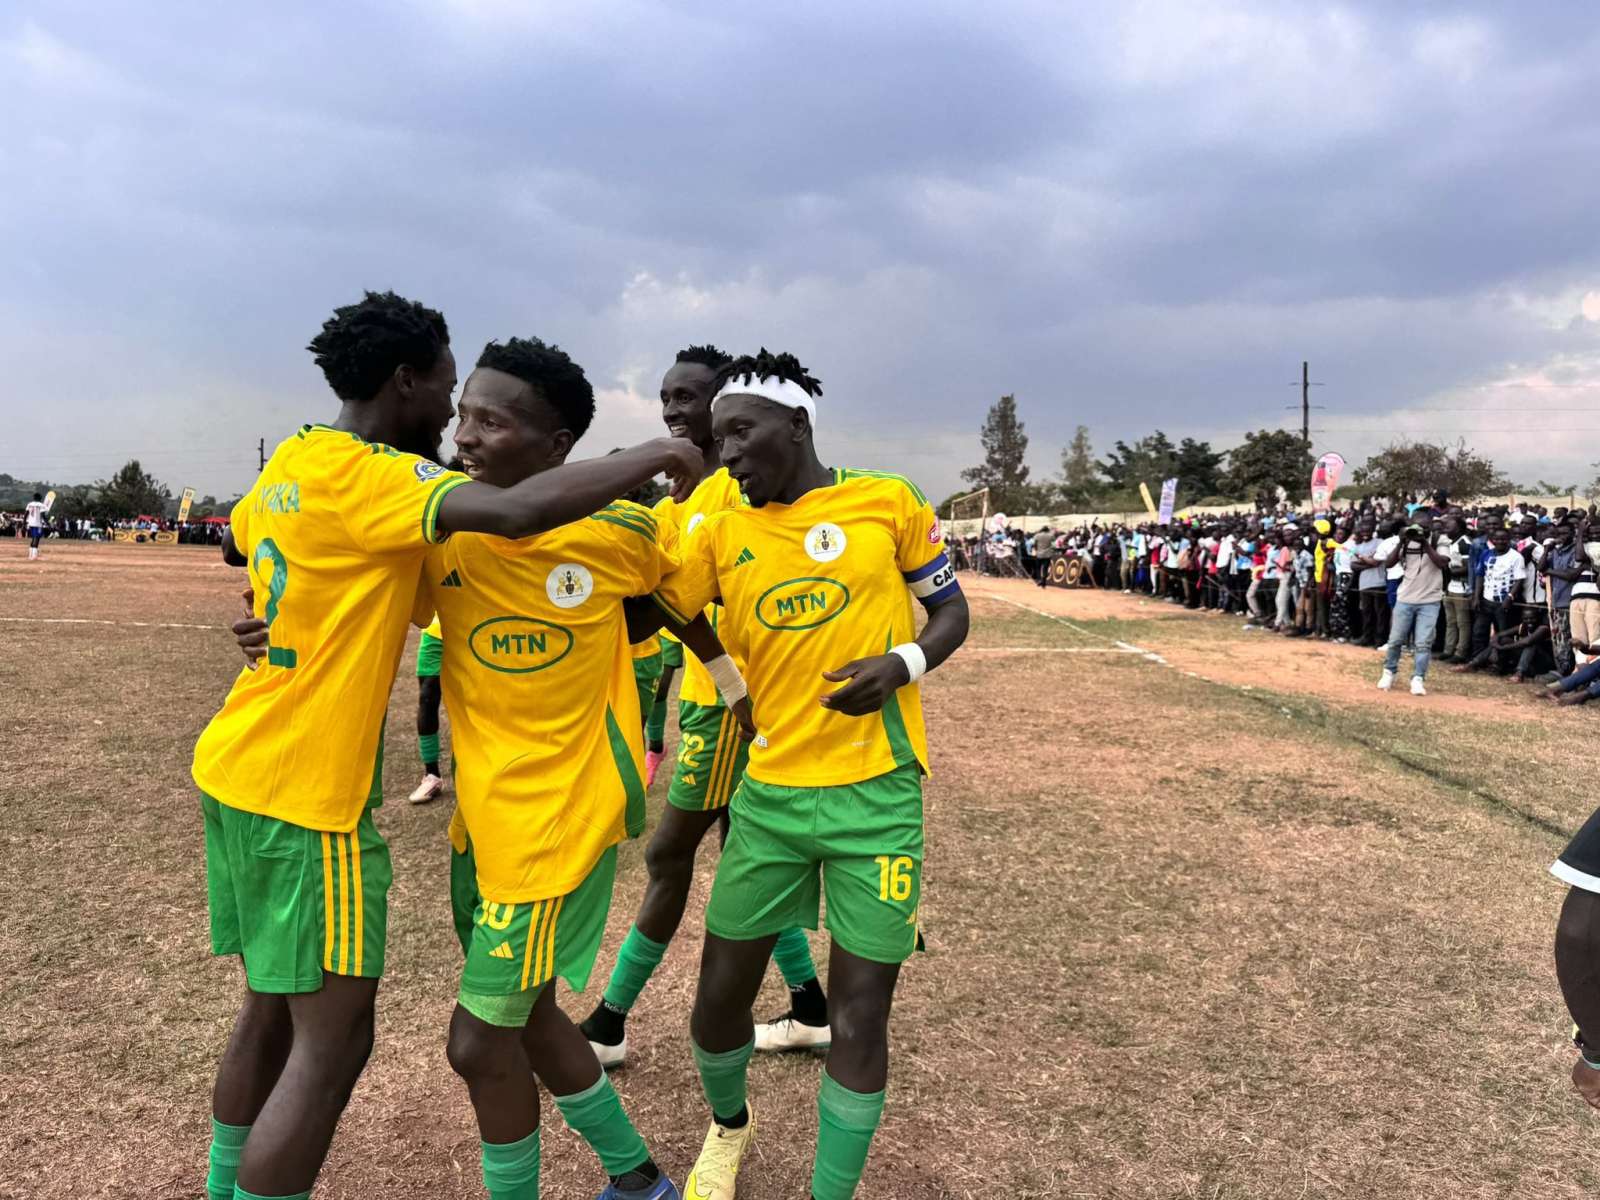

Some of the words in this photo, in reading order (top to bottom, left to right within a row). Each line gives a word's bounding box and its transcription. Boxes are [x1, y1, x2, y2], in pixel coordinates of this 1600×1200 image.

[776, 591, 826, 616] MTN
[491, 633, 546, 654] MTN
[874, 855, 913, 901] 16
